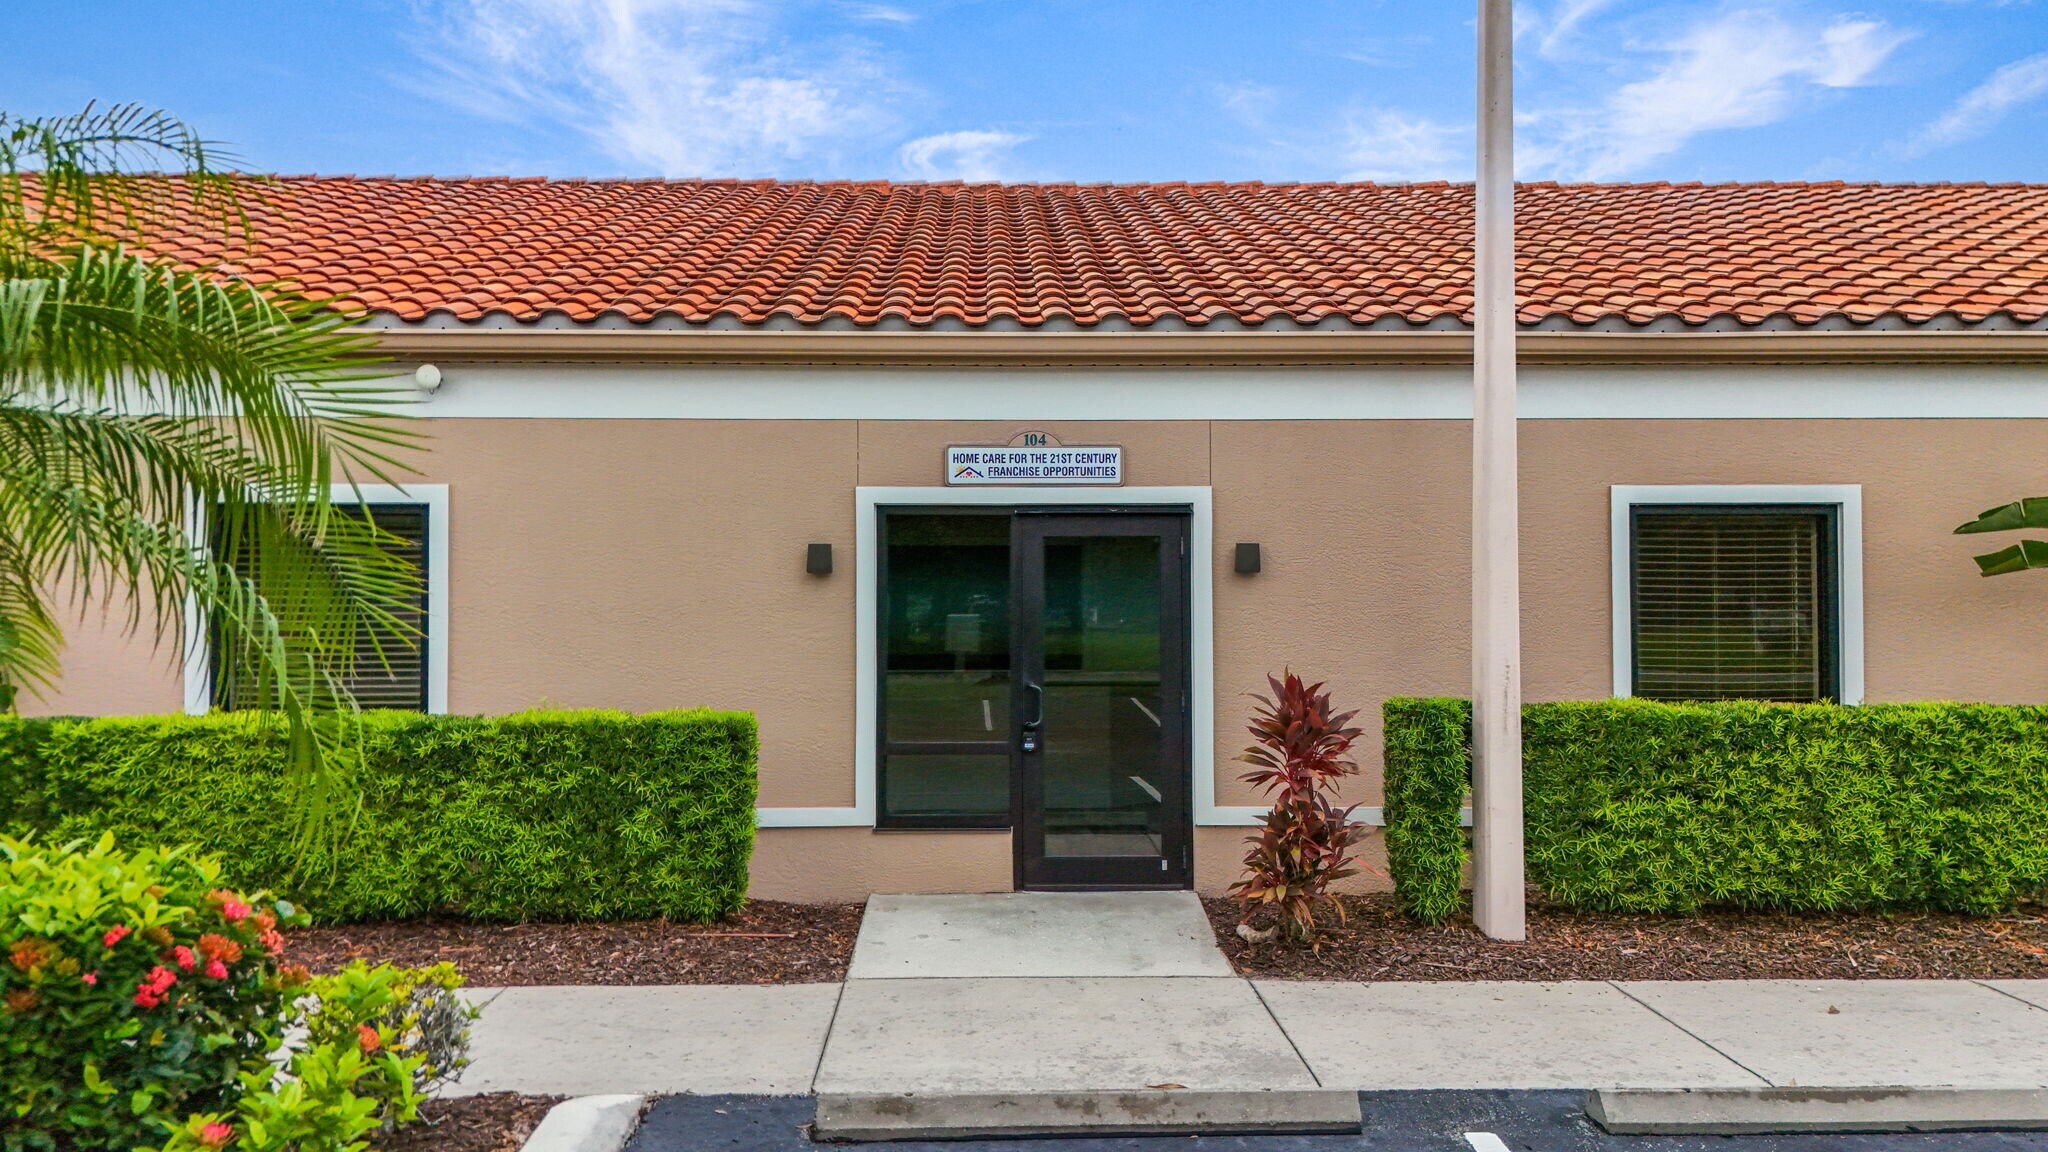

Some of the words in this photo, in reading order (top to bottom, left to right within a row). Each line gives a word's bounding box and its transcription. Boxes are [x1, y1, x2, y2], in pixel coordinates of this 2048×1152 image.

[1023, 433, 1047, 447] 104
[952, 453, 980, 464] HOME
[982, 453, 1006, 464] CARE
[1009, 453, 1028, 464] FOR
[1030, 453, 1047, 464] THE
[1050, 453, 1073, 464] 21ST
[1075, 453, 1117, 464] CENTURY
[988, 466, 1040, 477] FRANCHISE
[1043, 466, 1116, 477] OPPORTUNITIES
